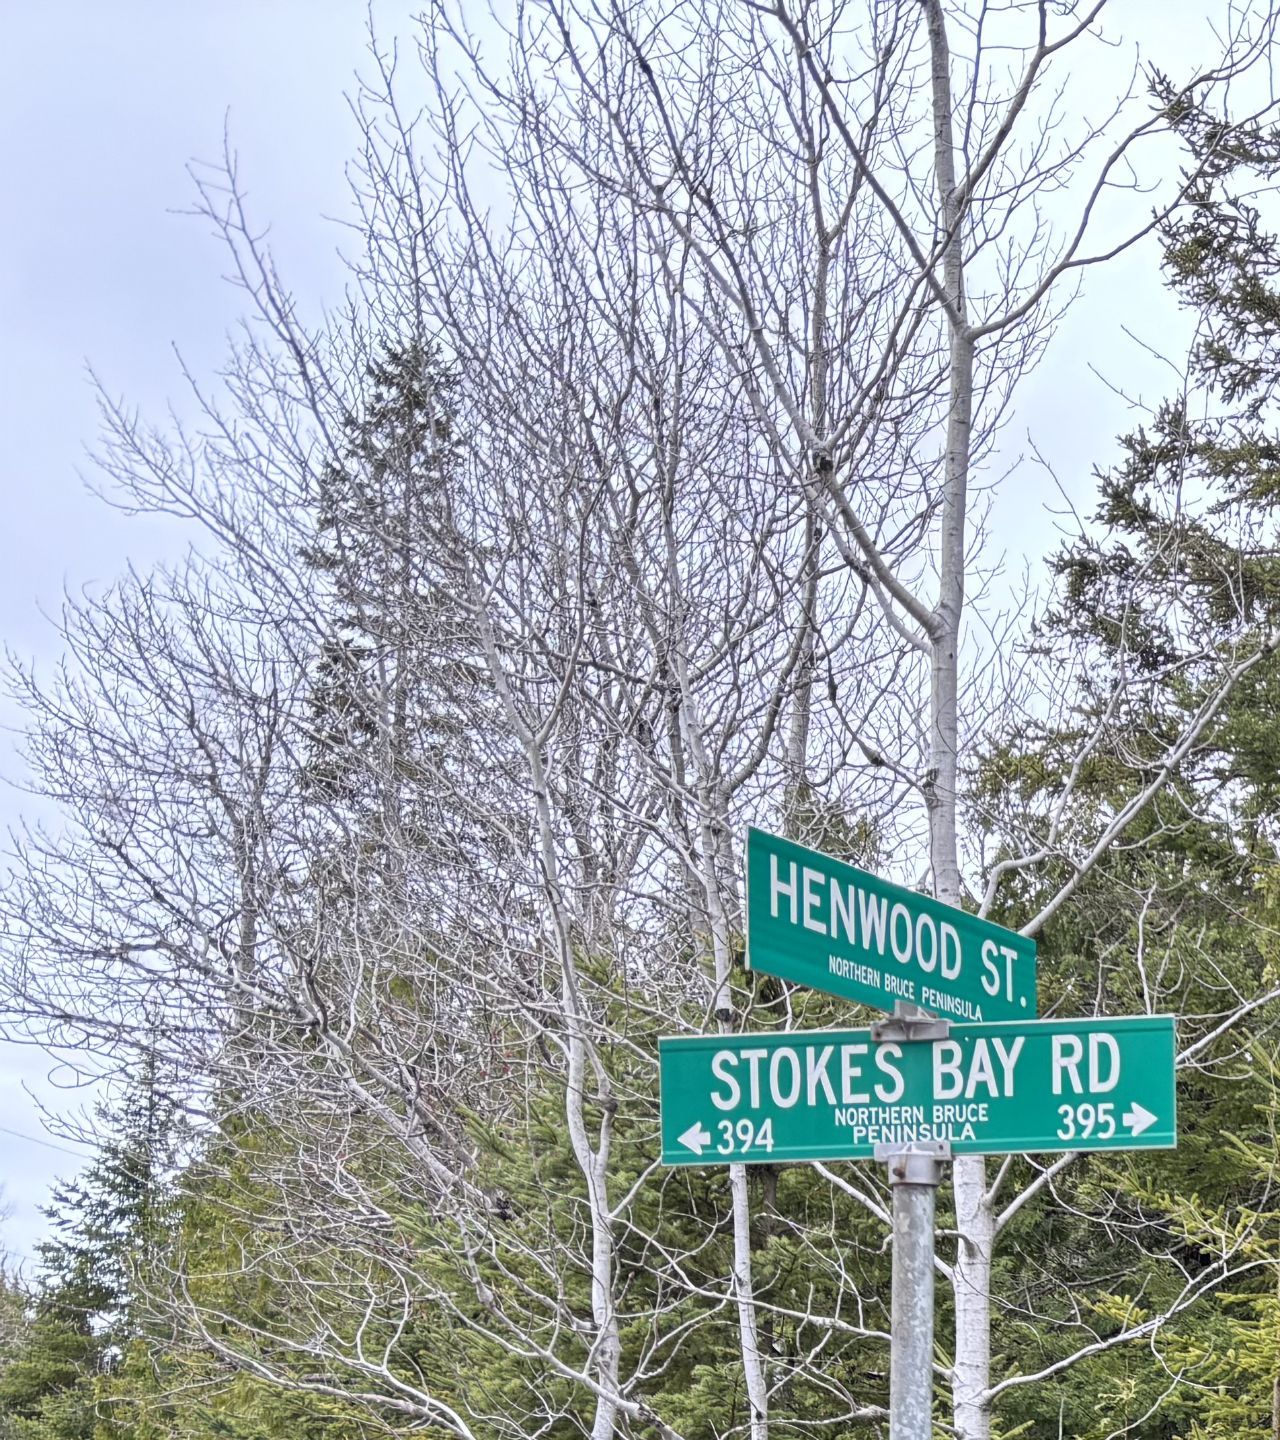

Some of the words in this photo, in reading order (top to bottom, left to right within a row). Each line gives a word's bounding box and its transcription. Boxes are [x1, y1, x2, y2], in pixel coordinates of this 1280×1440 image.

[769, 853, 962, 981] HENWOOD
[980, 939, 1028, 1008] ST.
[828, 954, 881, 988] NORTHERN
[884, 972, 916, 1000] BRUCE
[921, 986, 983, 1022] PENINSULA
[710, 1042, 905, 1111] STOKES
[932, 1036, 1025, 1100] BAY
[1051, 1032, 1121, 1096] RD
[834, 1104, 924, 1126] NORTHERN
[932, 1103, 988, 1123] BRUCE
[852, 1123, 976, 1145] PENINSULA
[1056, 1102, 1116, 1141] 395
[716, 1117, 774, 1155] 394
